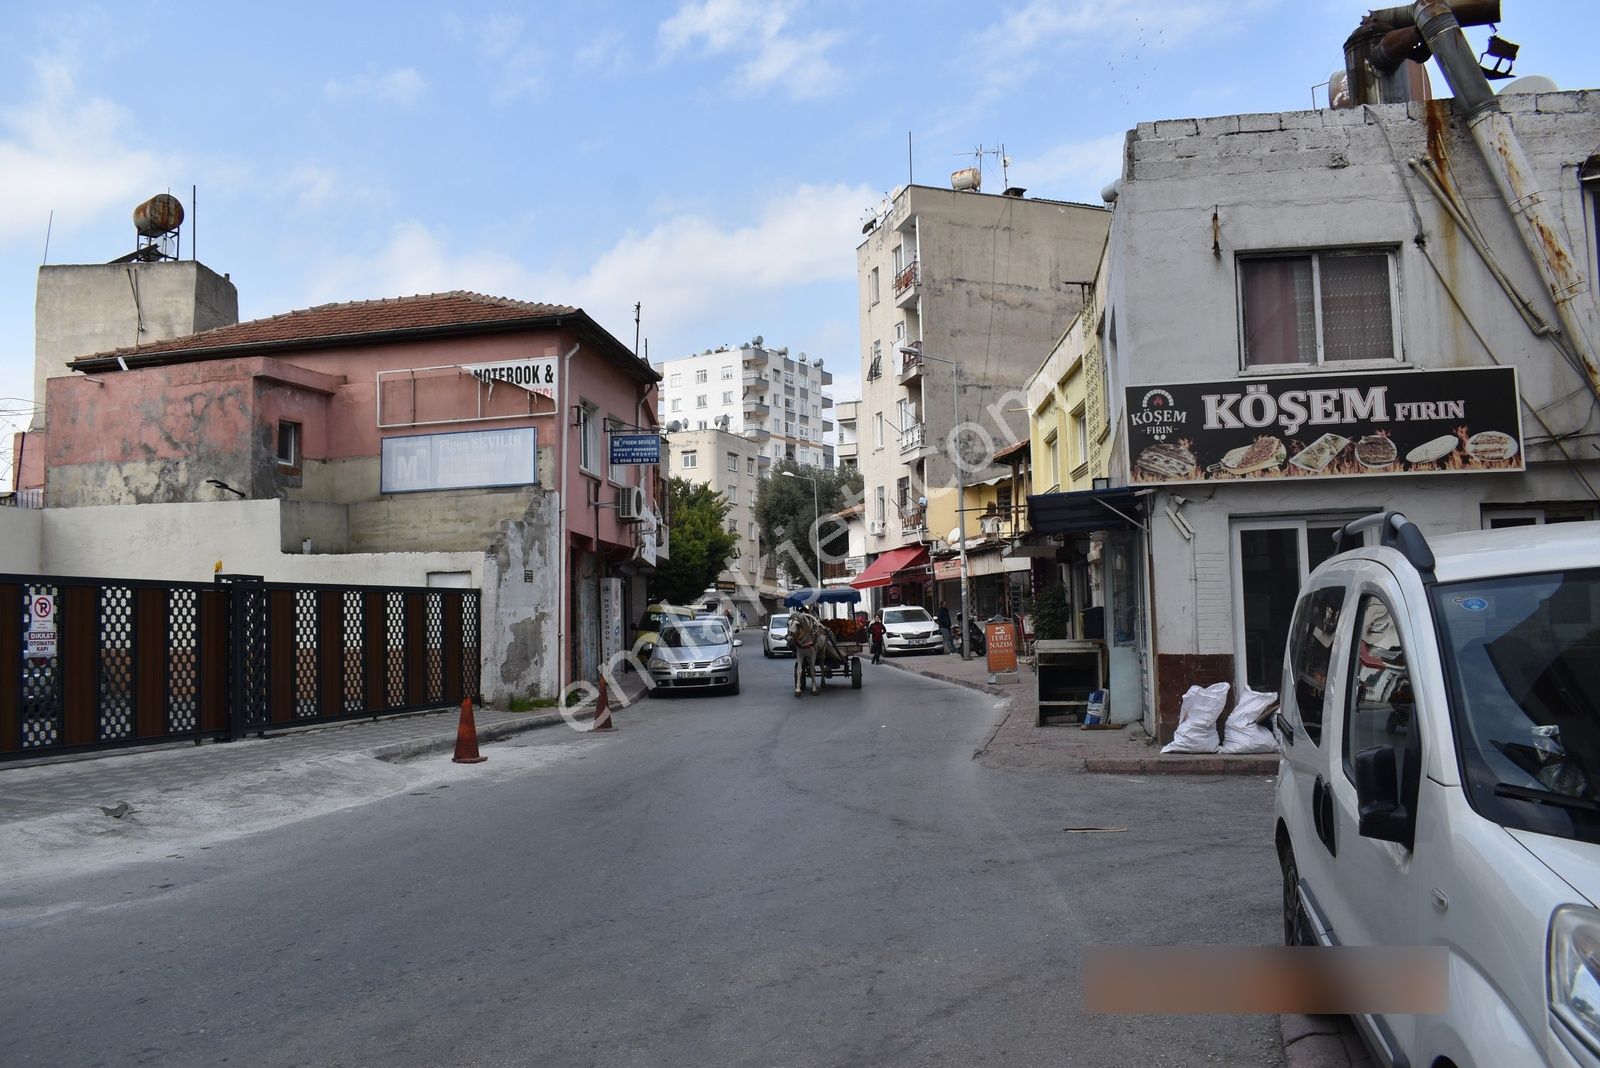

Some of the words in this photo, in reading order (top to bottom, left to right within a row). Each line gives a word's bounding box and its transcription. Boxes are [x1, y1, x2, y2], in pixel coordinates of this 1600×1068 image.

[545, 364, 554, 384] &
[1131, 408, 1188, 426] KÖŞEM
[1201, 384, 1390, 436] KÖŞEM
[1394, 400, 1465, 422] FIRIN
[1146, 426, 1173, 434] FIRIN
